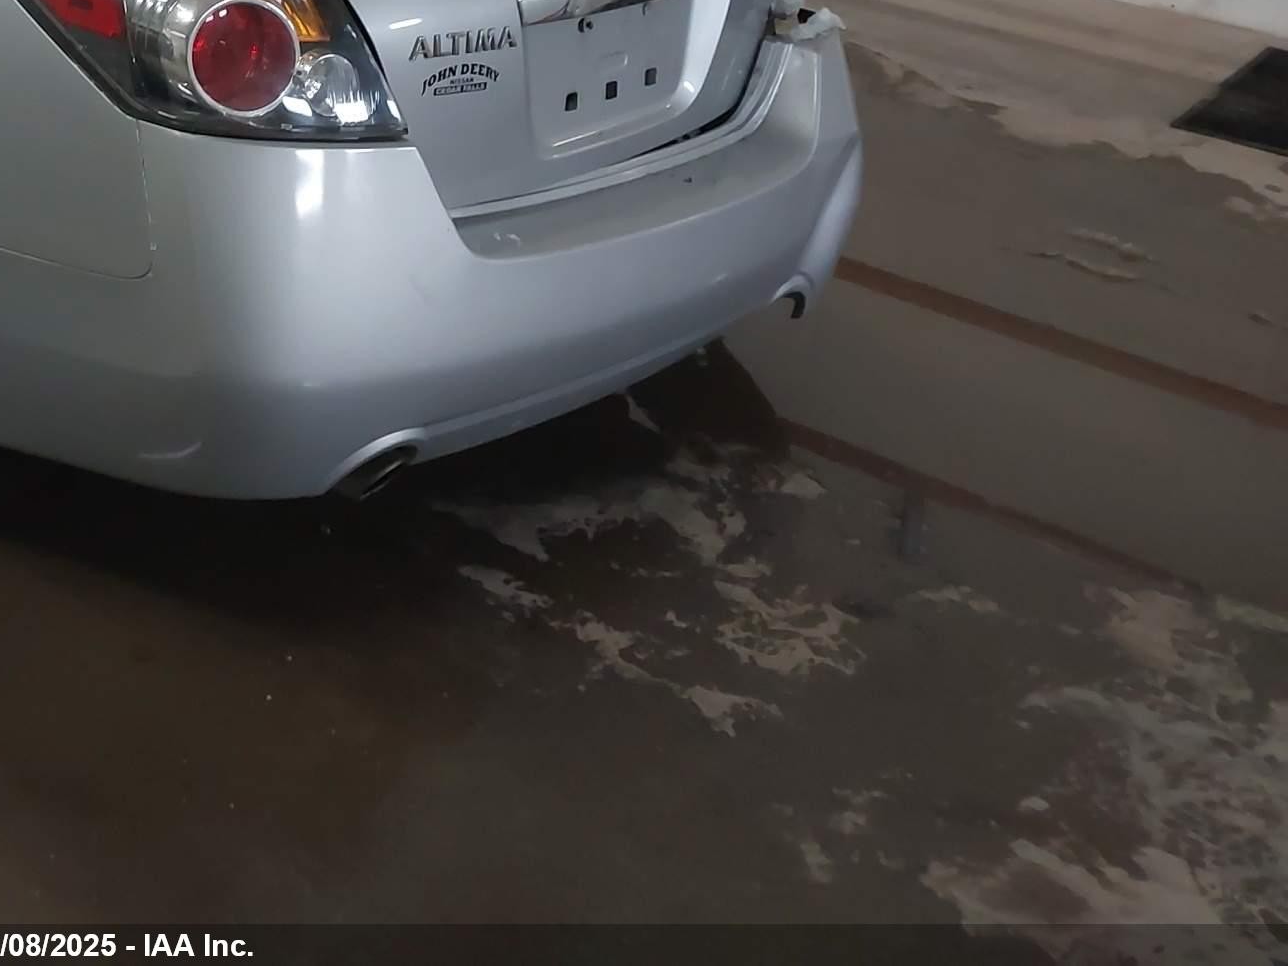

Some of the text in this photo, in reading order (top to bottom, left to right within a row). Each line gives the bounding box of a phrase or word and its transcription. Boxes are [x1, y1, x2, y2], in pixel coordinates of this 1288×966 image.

[409, 26, 517, 61] ALTIMA
[421, 63, 500, 97] JOHN DEERY
